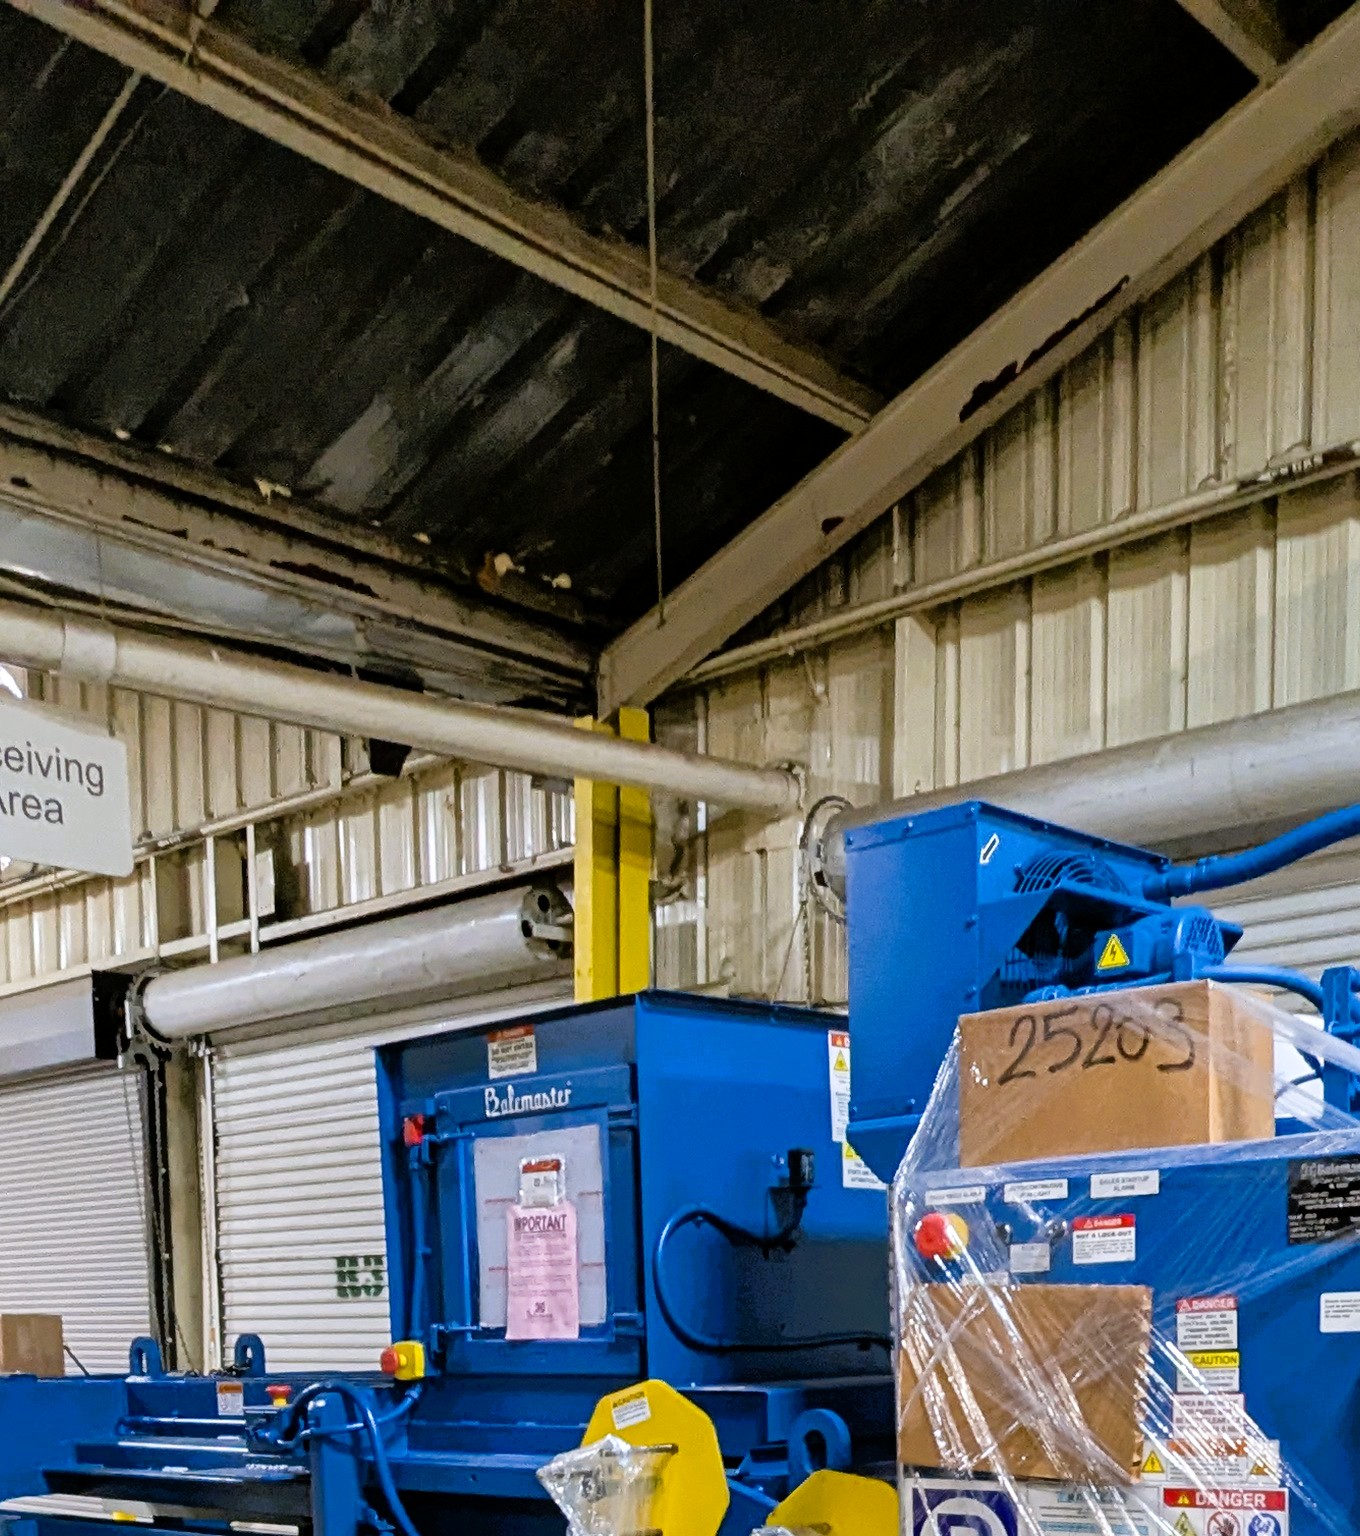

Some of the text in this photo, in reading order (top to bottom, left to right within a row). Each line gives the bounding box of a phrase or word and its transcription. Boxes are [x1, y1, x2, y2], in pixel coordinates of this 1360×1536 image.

[997, 996, 1197, 1086] 25203
[484, 1081, 573, 1119] Balemaster
[1192, 1354, 1238, 1367] CAUTION
[1195, 1491, 1267, 1508] DANGER
